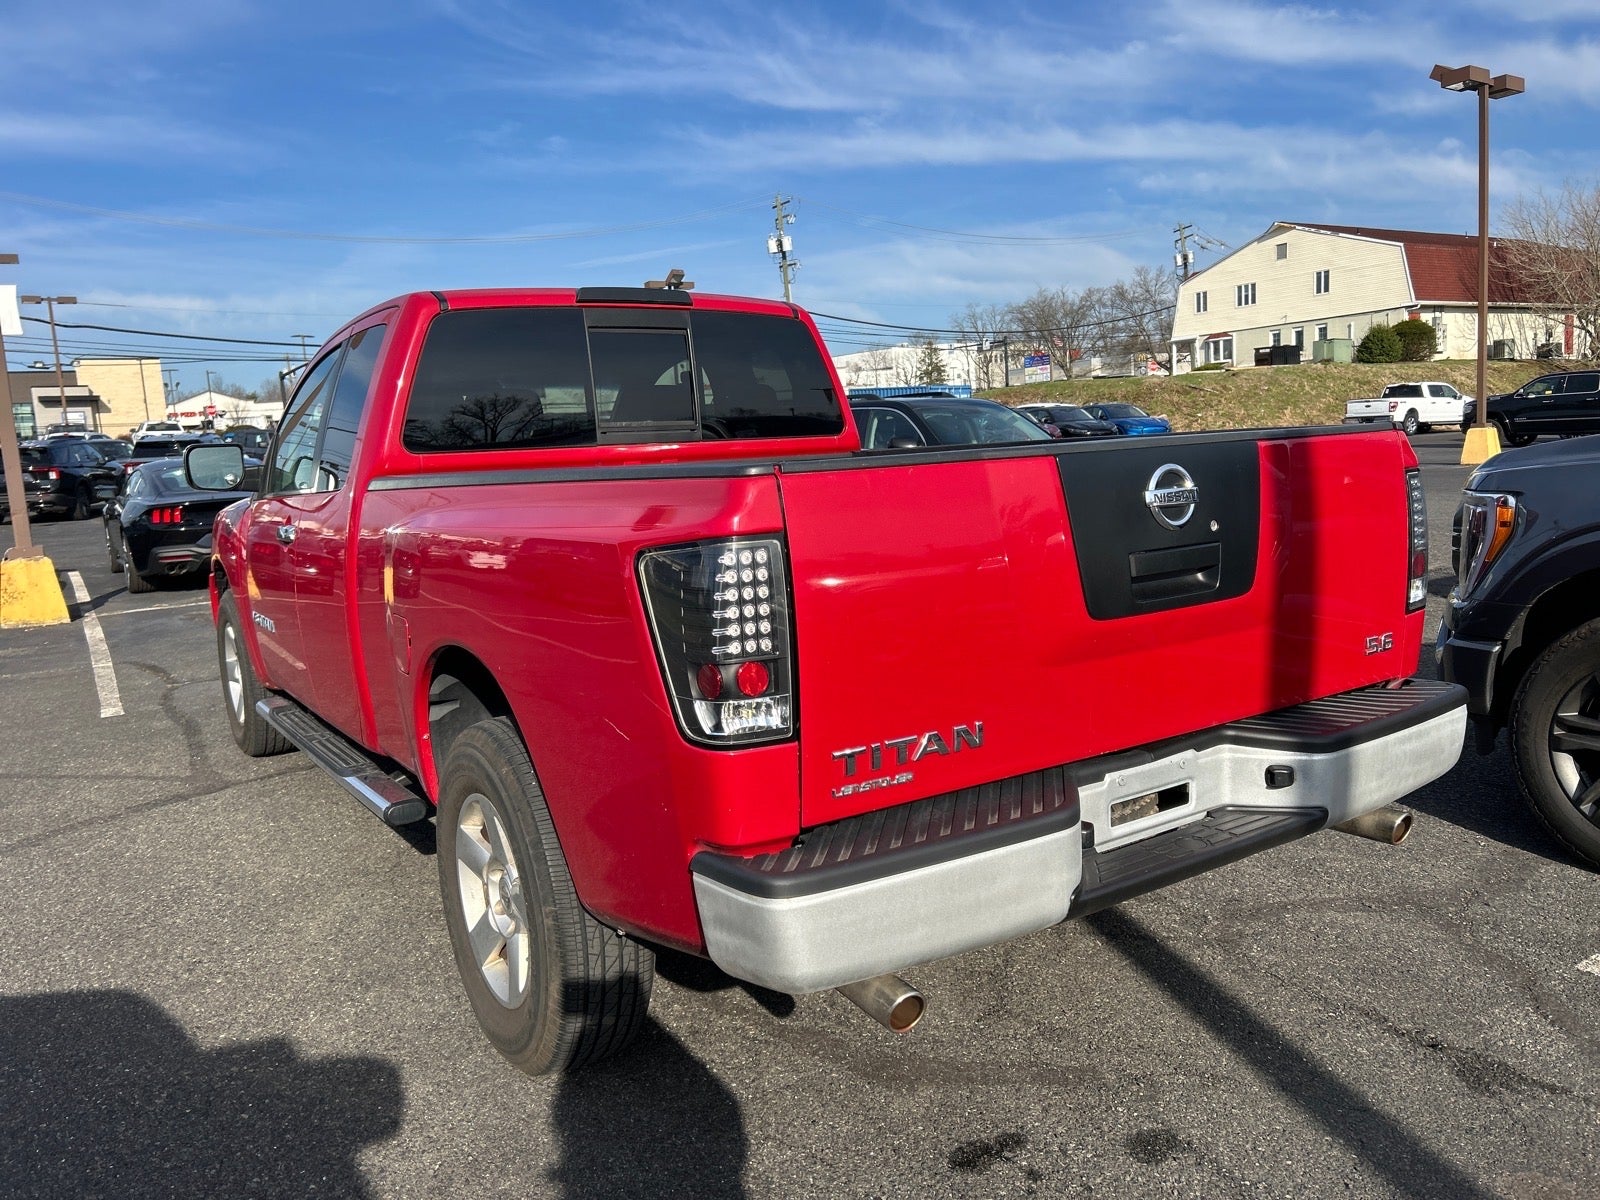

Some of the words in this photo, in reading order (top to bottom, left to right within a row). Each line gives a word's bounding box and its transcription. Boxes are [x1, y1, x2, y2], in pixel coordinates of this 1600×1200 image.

[1153, 487, 1199, 504] NISSAN
[1365, 632, 1393, 655] 5.6
[831, 720, 984, 777] TITAN
